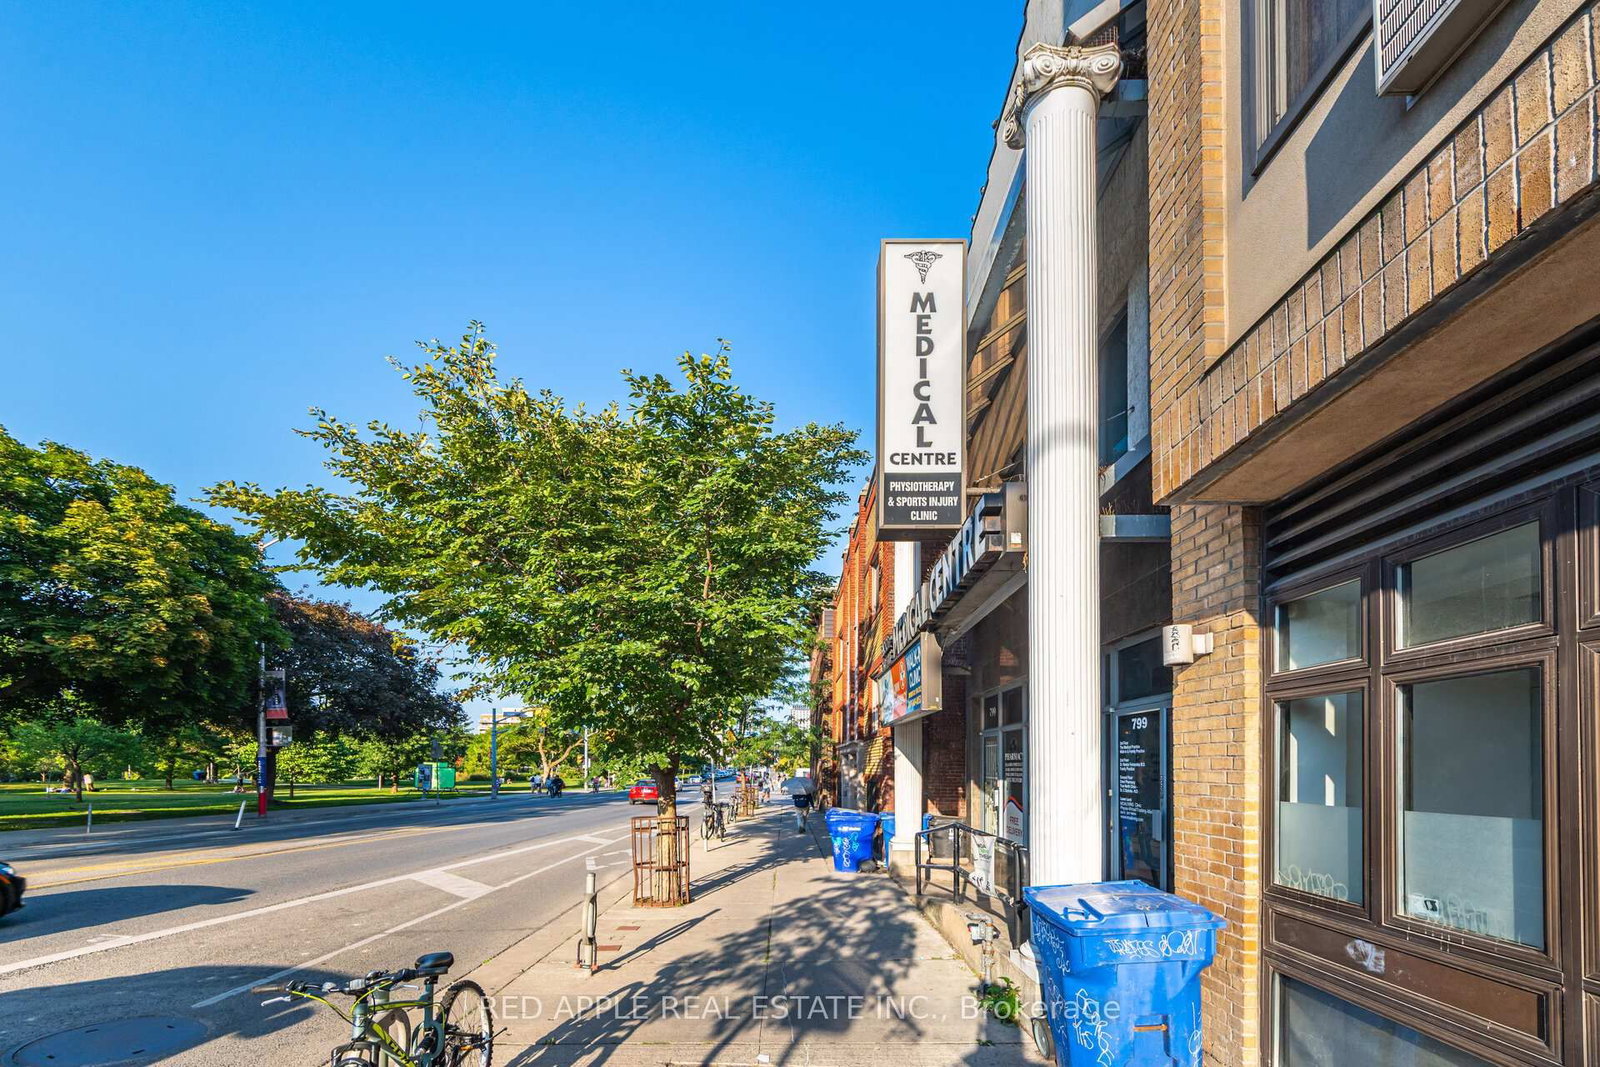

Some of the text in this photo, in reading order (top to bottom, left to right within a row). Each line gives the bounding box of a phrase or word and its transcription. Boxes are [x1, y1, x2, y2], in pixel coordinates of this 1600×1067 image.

[910, 292, 937, 448] MEDICAL
[889, 452, 957, 466] CENTRE
[889, 481, 955, 492] PHYSIOTHERAPY
[887, 496, 959, 507] & SPORTS INJURY
[910, 510, 938, 521] CLINIC
[930, 494, 994, 614] CENTRE
[1131, 716, 1148, 730] 799
